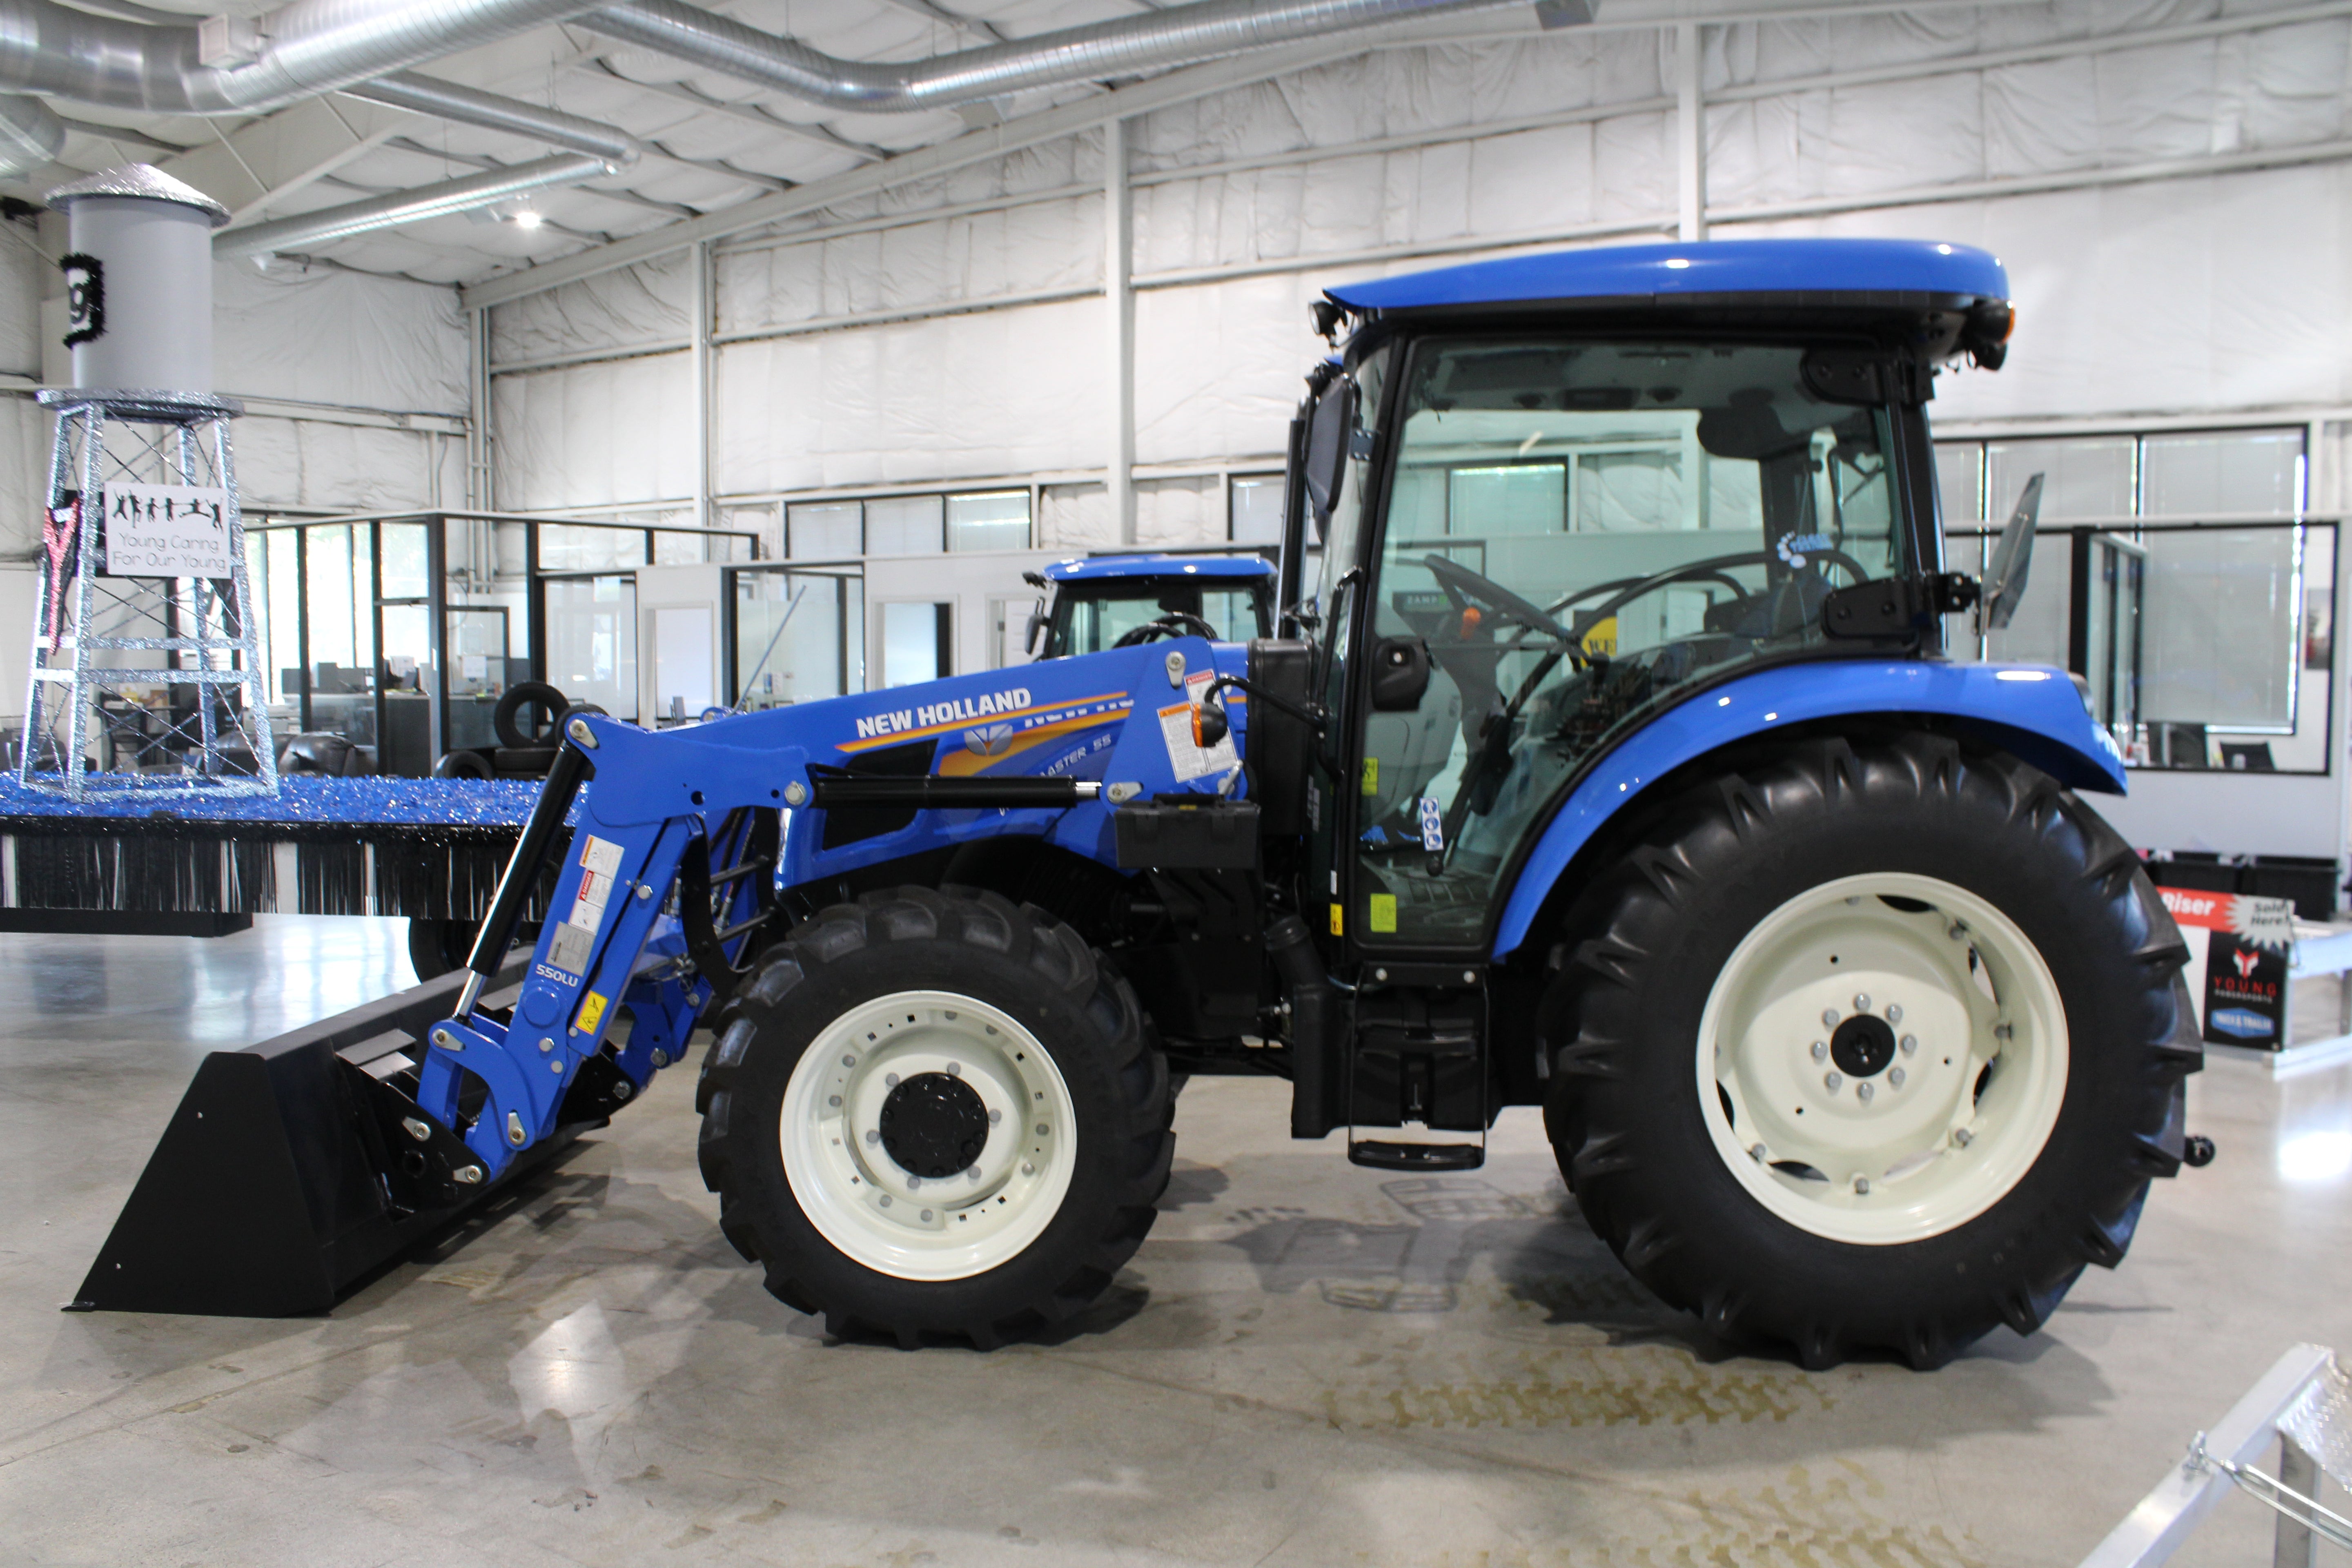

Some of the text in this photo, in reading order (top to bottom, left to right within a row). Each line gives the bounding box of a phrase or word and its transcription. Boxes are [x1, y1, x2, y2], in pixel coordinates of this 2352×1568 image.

[119, 532, 219, 554] Young Caring
[113, 551, 225, 572] For Our Young
[856, 709, 912, 739] NEW
[917, 688, 1032, 727] HOLLAND
[2214, 976, 2277, 998] YOUNG
